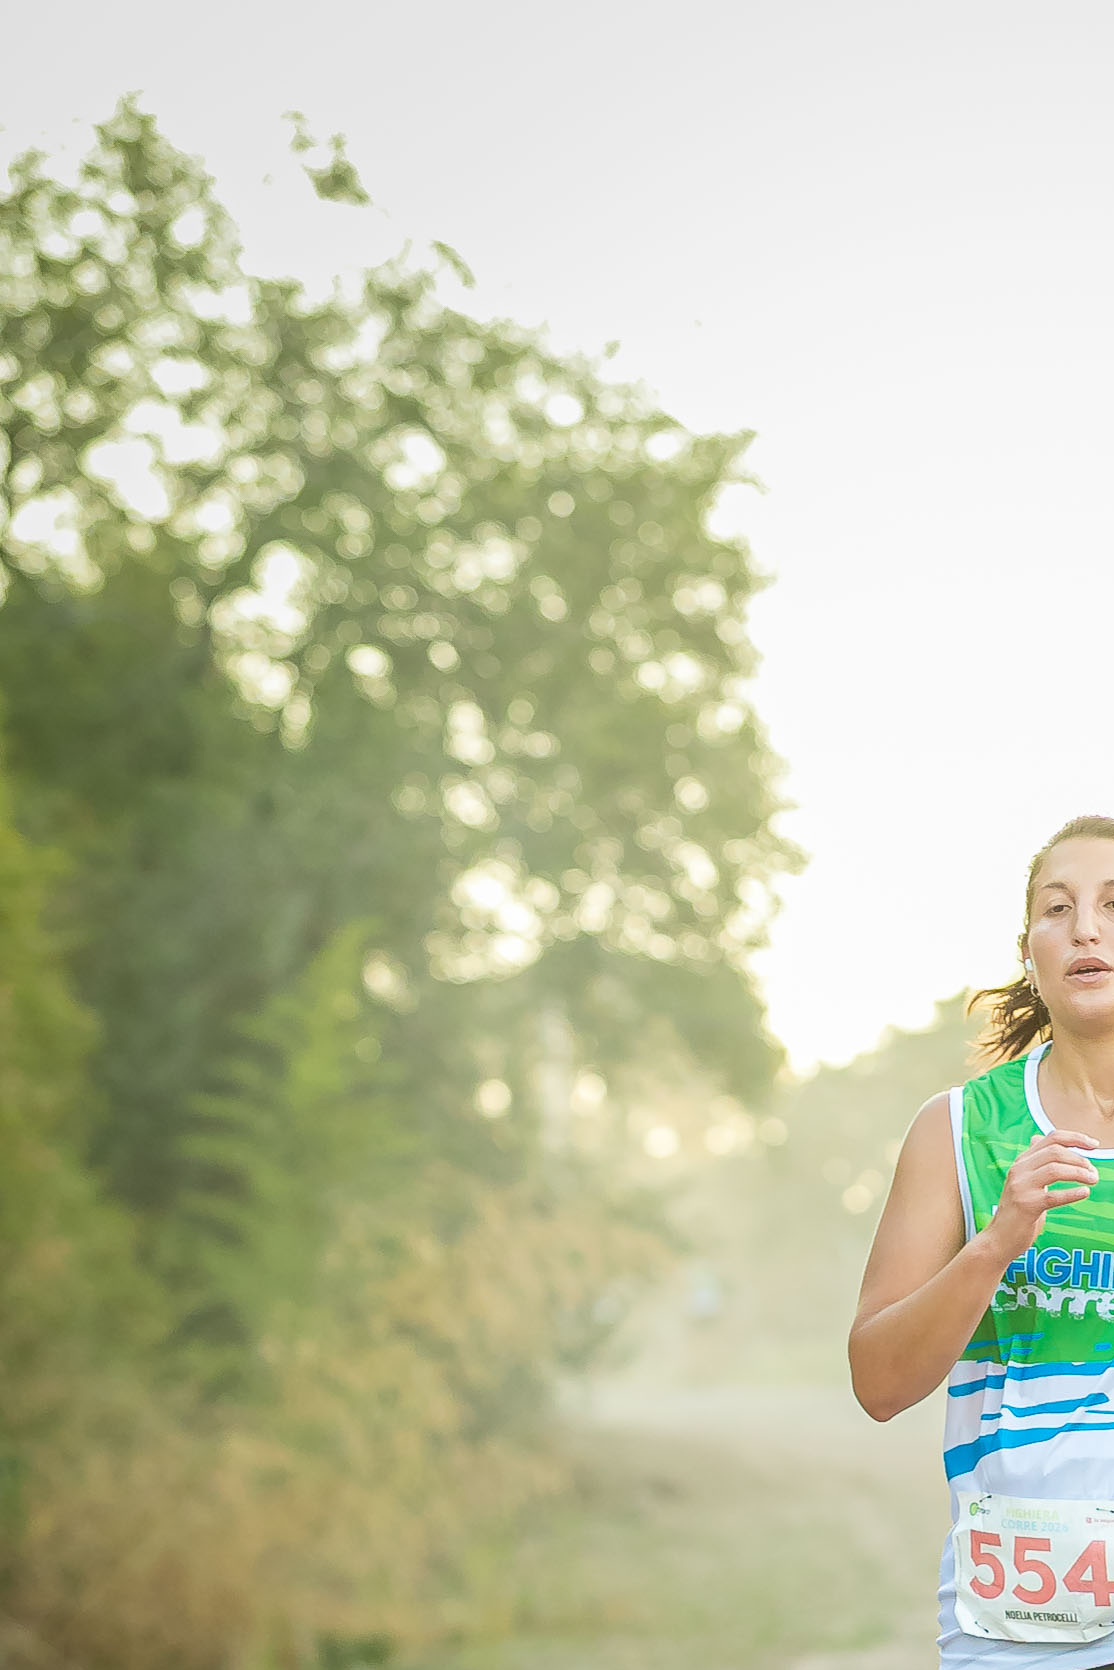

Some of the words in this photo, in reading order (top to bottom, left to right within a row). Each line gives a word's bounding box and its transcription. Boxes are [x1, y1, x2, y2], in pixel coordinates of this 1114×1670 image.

[1001, 1518, 1037, 1532] CORRE
[1040, 1521, 1069, 1532] 2026
[1005, 1610, 1033, 1621] NOELIA
[1033, 1612, 1078, 1622] PETROCELLI
